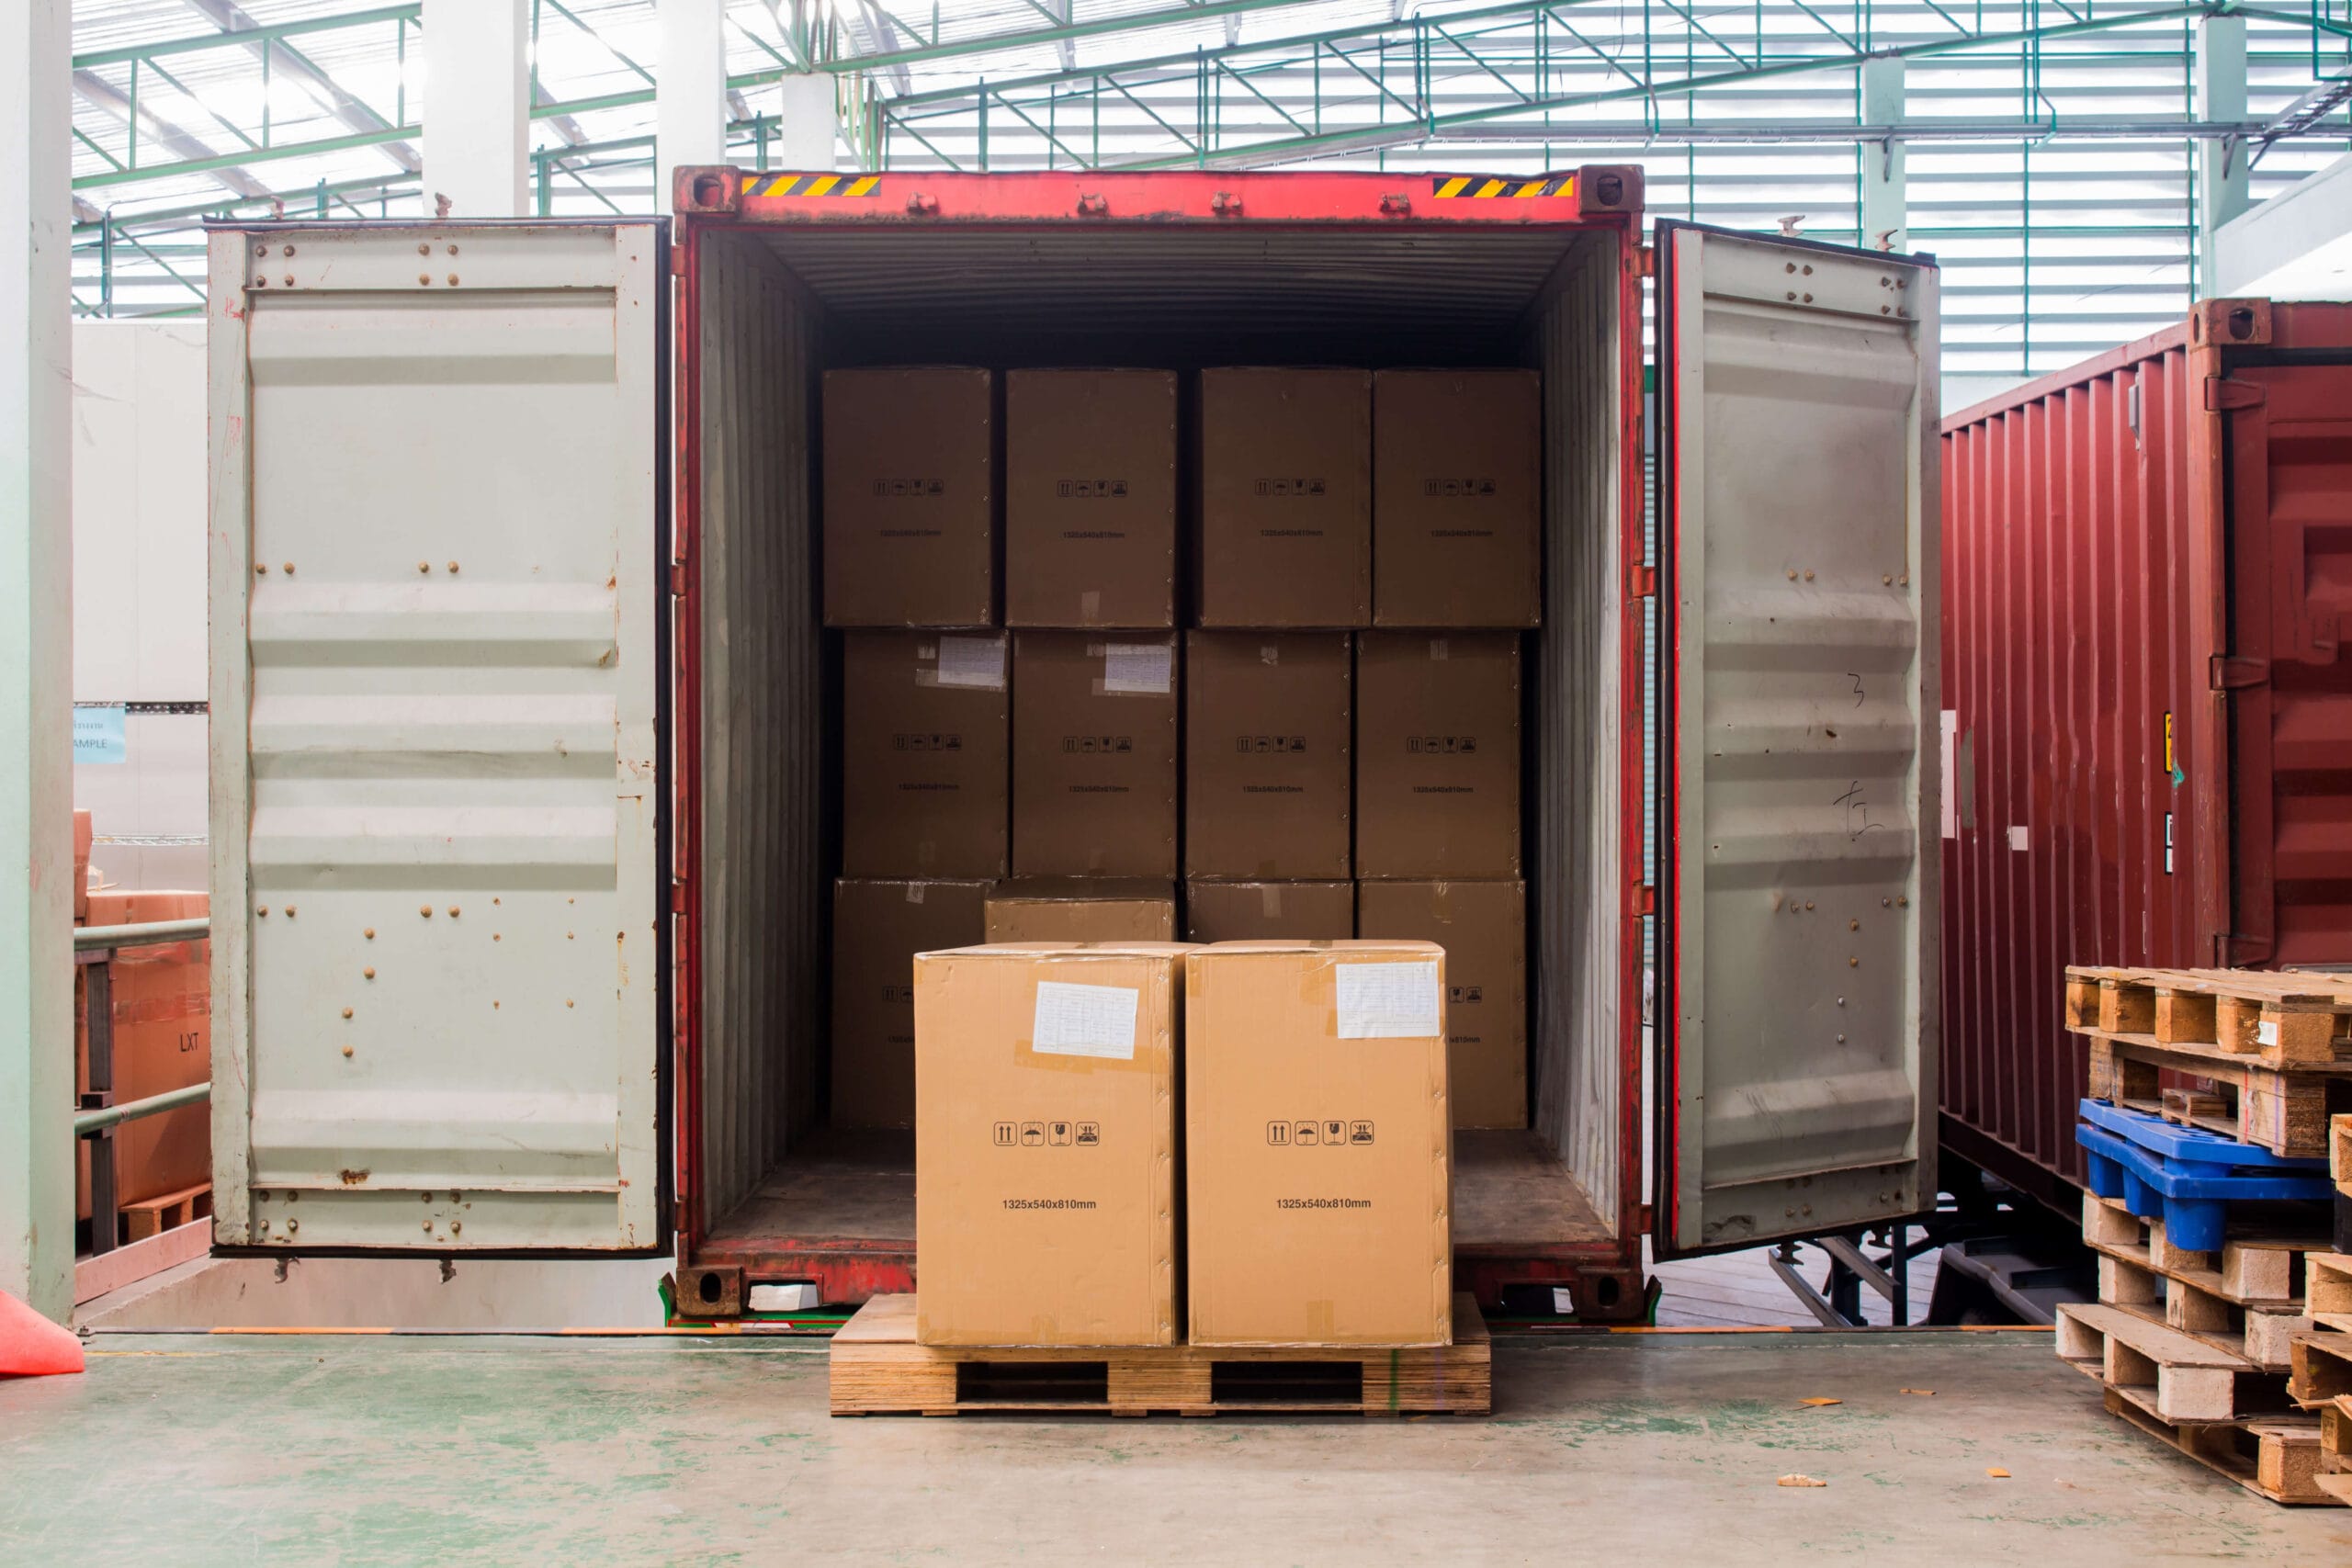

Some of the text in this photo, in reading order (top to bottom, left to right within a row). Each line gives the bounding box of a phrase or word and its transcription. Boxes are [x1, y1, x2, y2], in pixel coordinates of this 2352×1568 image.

[180, 1032, 199, 1053] LXT
[1002, 1199, 1097, 1210] 1325x540x810mm
[1276, 1198, 1372, 1209] 1325x540x810mm
